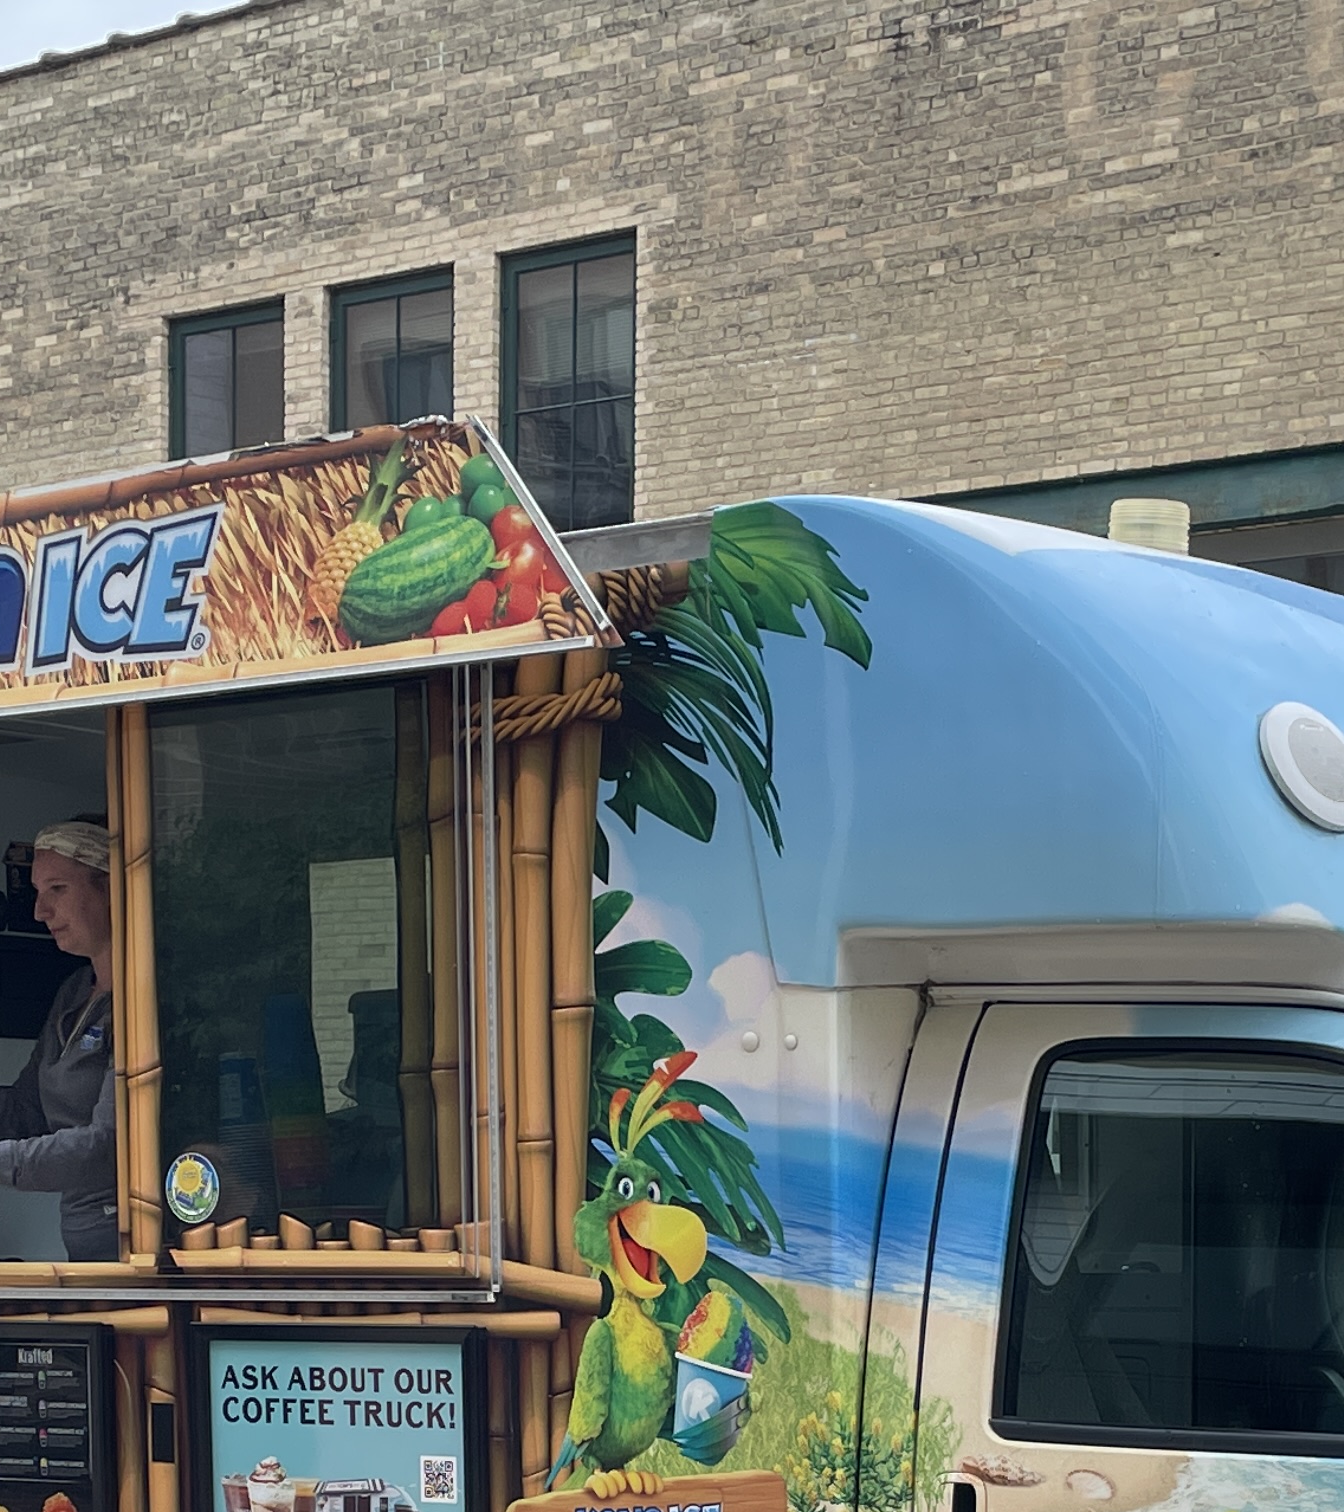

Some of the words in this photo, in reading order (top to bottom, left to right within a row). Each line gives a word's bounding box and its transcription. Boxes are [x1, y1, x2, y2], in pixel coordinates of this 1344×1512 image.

[31, 508, 220, 669] ICE
[221, 1364, 279, 1391] ASK
[287, 1366, 385, 1393] ABOUT
[394, 1368, 455, 1395] OUR
[222, 1396, 335, 1425] COFFEE
[344, 1400, 457, 1429] TRUCK!
